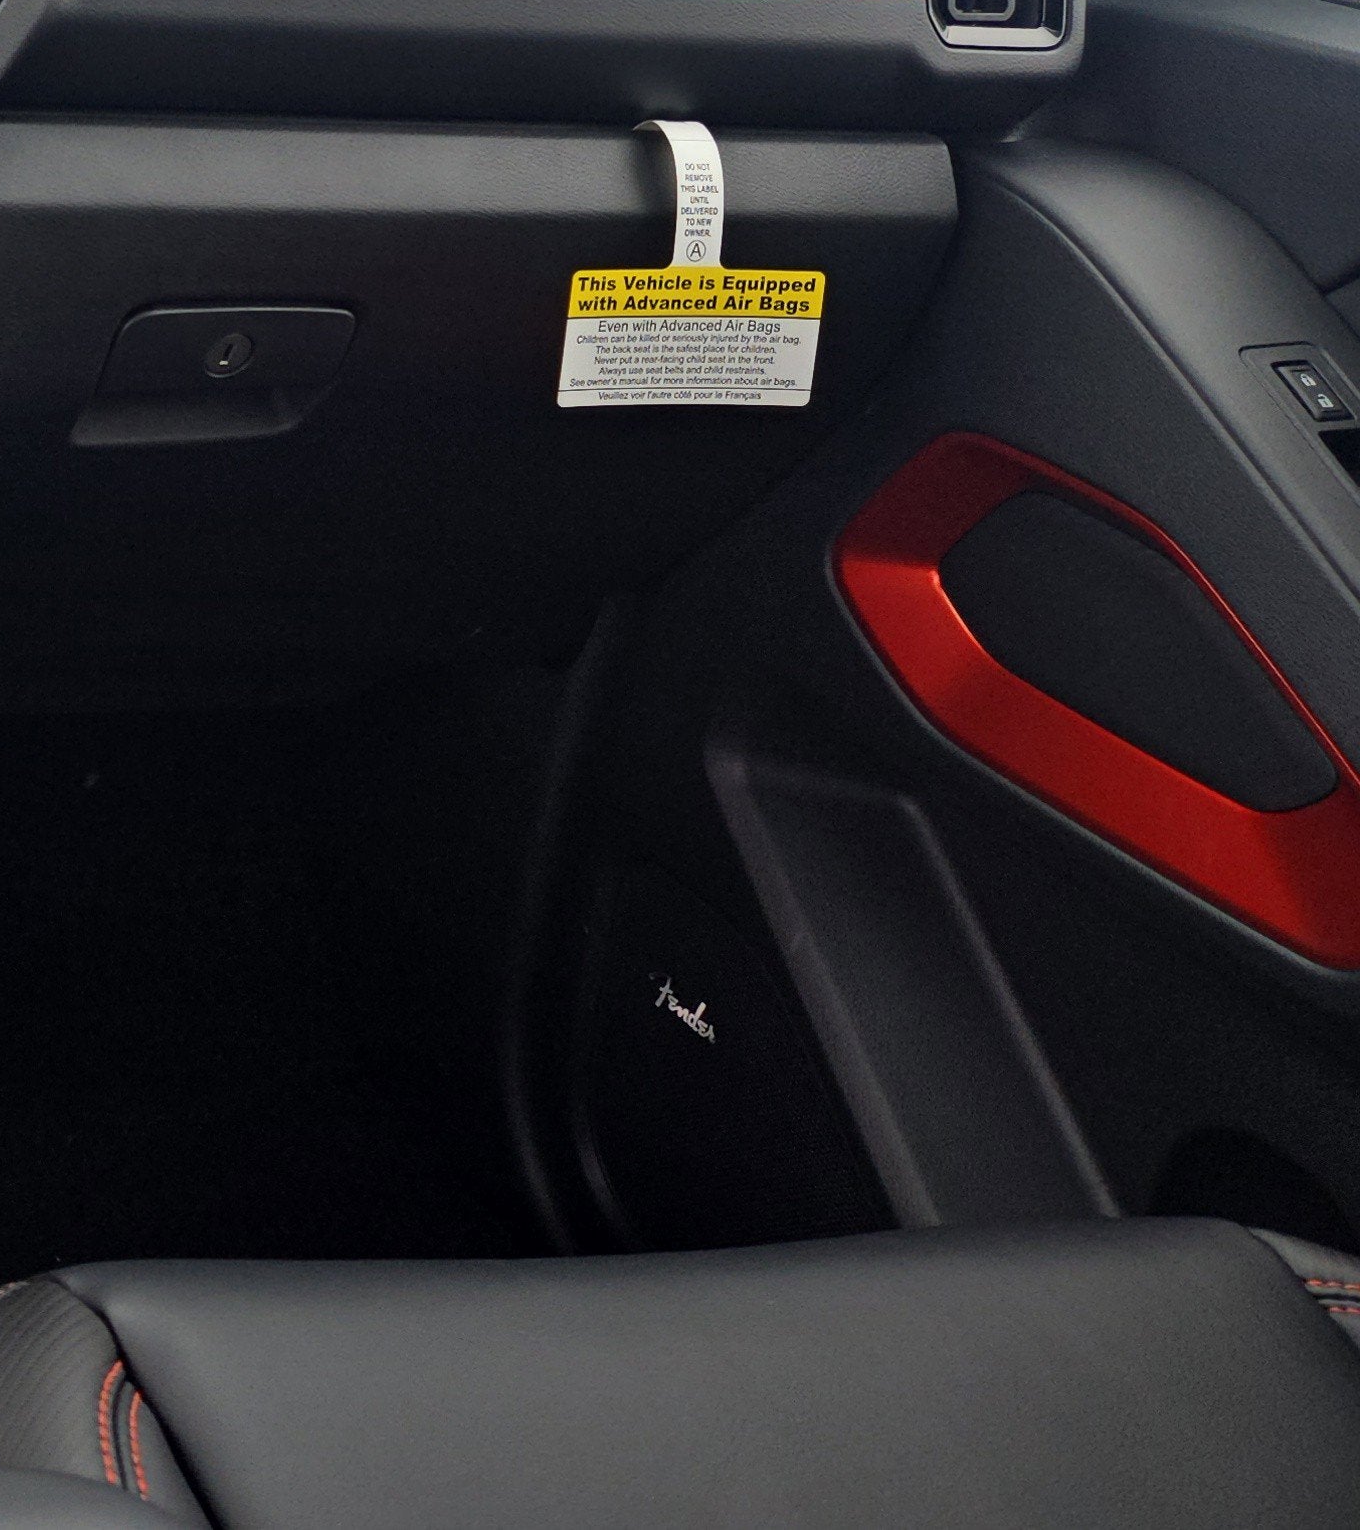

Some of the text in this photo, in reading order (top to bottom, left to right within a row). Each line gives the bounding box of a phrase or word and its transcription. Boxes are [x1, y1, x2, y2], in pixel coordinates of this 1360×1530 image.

[684, 174, 713, 182] REMOVE
[680, 184, 719, 193] THIS LABEL
[690, 196, 709, 204] UNTIL
[680, 206, 719, 216] DELIVERED
[685, 218, 712, 226] TO NEW
[689, 242, 702, 257] A
[578, 275, 817, 295] This Vehicle is Equipped
[578, 295, 810, 315] with Advanced Air Bags
[598, 319, 781, 335] Even with Advanced Air Bags
[577, 335, 608, 344] Children
[627, 334, 638, 343] be
[639, 334, 660, 343] killed
[672, 334, 708, 343] seriously
[710, 334, 739, 343] injured
[740, 335, 751, 343] by
[753, 334, 767, 343] the
[769, 335, 780, 343] air
[595, 345, 611, 354] The
[612, 345, 631, 354] back
[633, 345, 651, 353] seat
[652, 345, 659, 353] is
[661, 345, 674, 353] the
[676, 345, 701, 353] safest
[703, 345, 725, 354] place
[727, 345, 739, 353] for
[594, 356, 618, 364] Never
[619, 356, 632, 364] put
[641, 356, 684, 365] rear-facing
[686, 356, 706, 364] child
[707, 356, 726, 364] seat
[738, 356, 751, 364] the
[598, 367, 626, 376] Always
[645, 367, 663, 375] seat
[664, 366, 684, 374] belts
[686, 366, 703, 374] and
[703, 366, 724, 374] child
[570, 378, 586, 387] See
[586, 377, 617, 386] owner's
[619, 377, 649, 385] manual
[650, 377, 661, 385] for
[685, 376, 732, 385] information
[734, 377, 759, 385] about
[760, 377, 772, 386] air
[649, 971, 716, 1044] Fender
